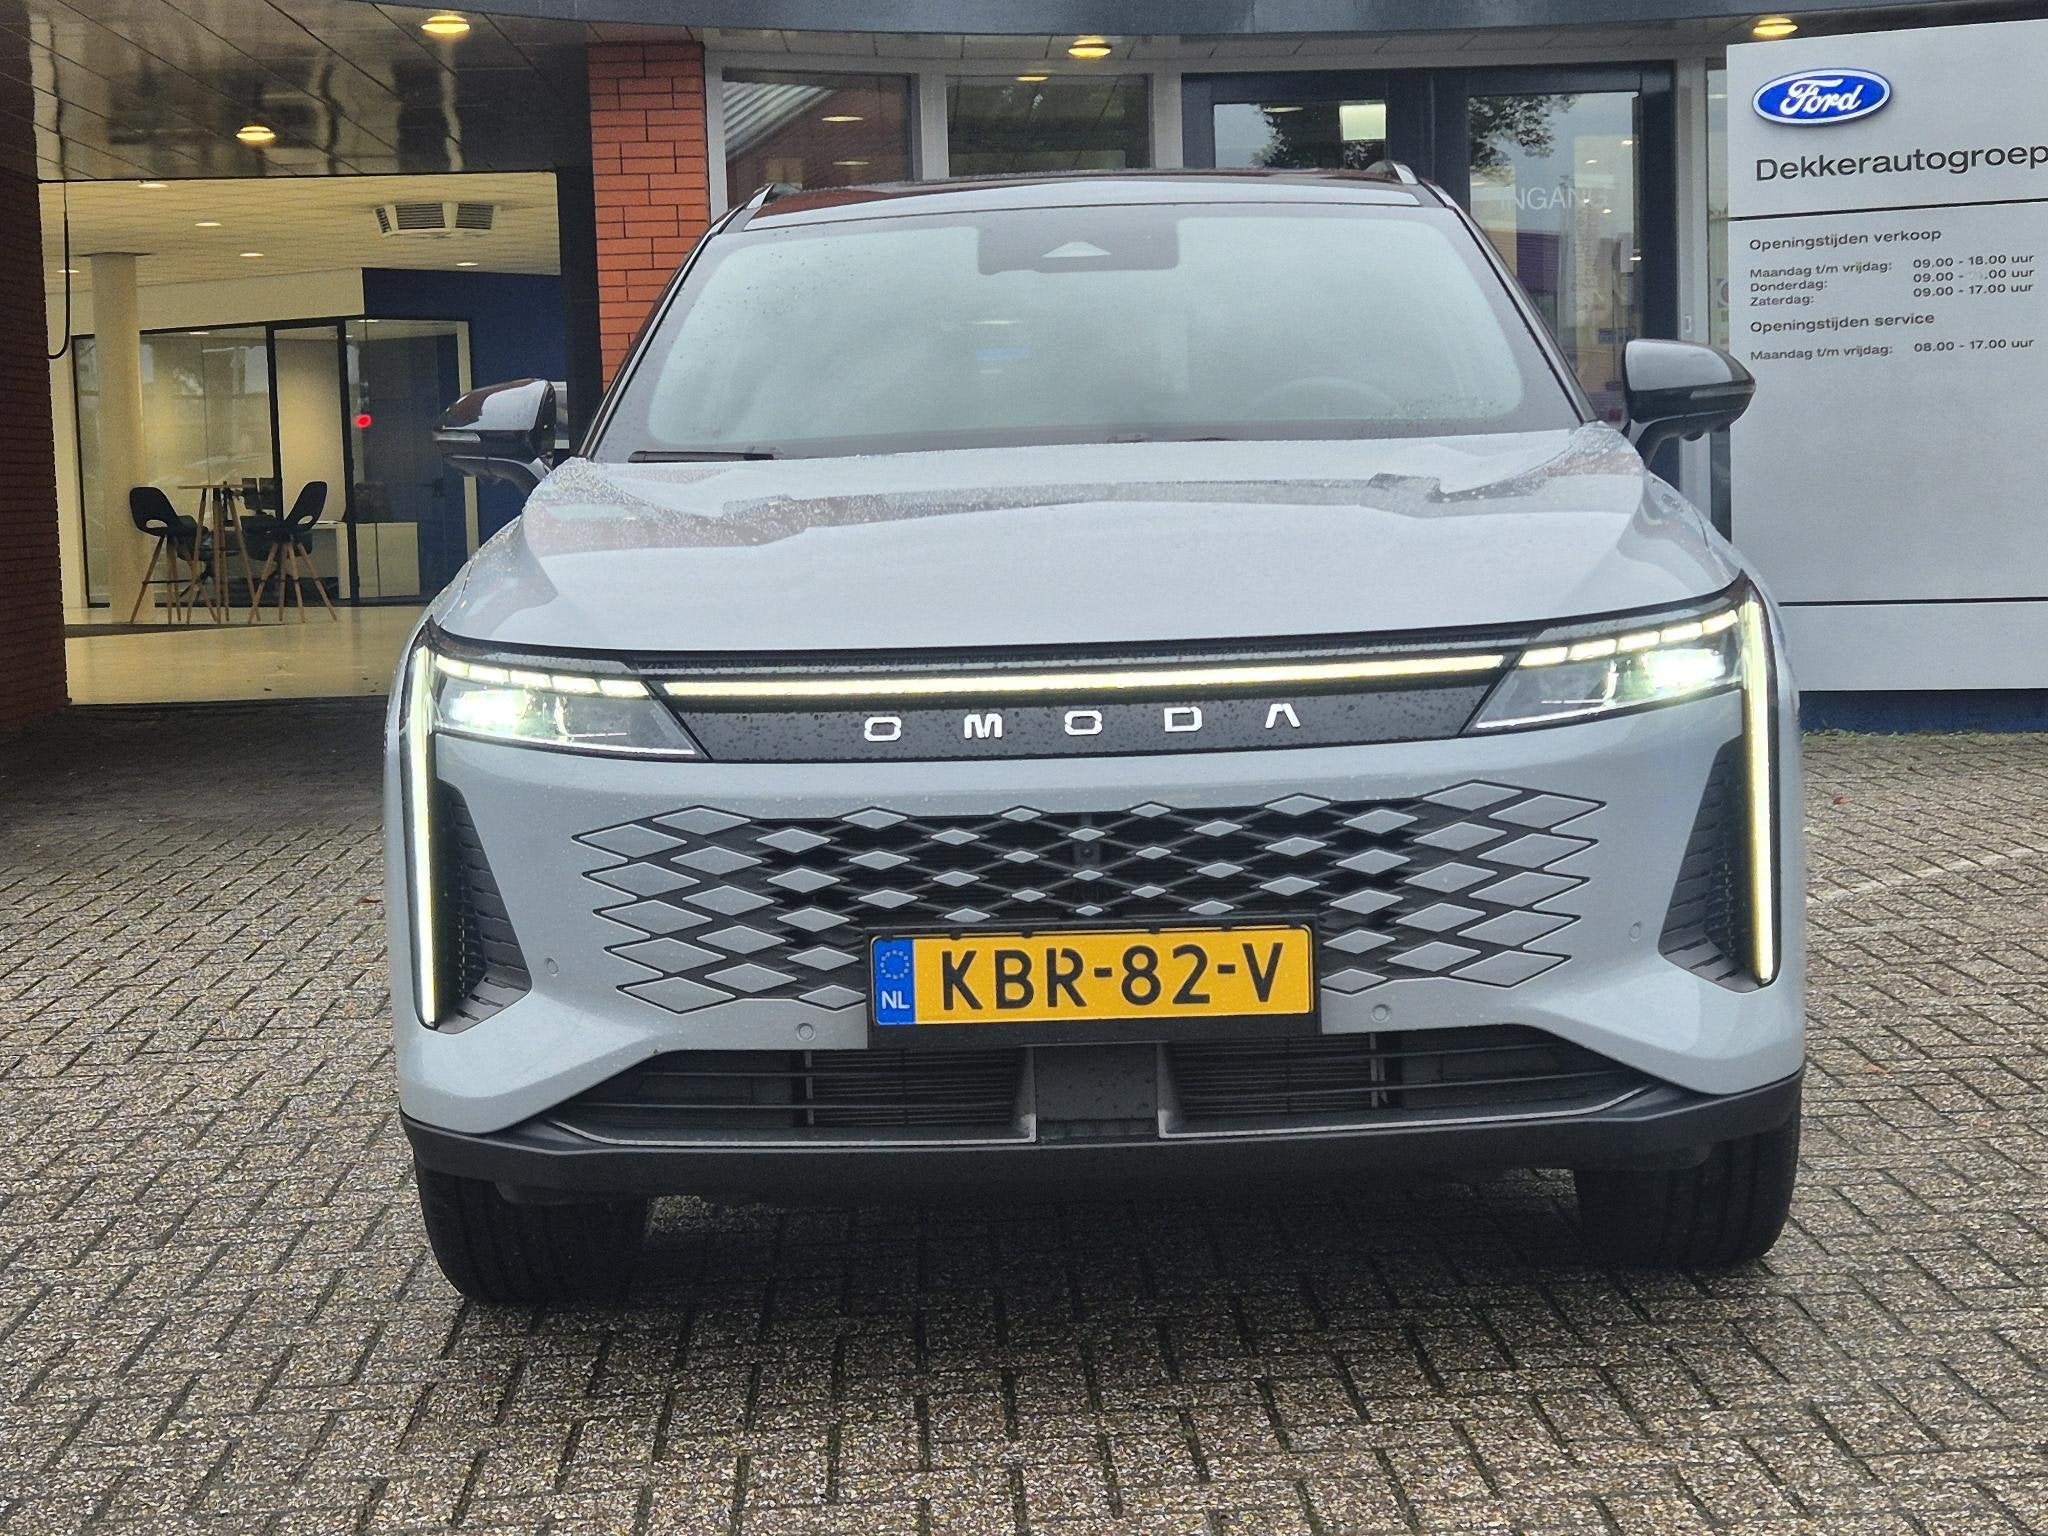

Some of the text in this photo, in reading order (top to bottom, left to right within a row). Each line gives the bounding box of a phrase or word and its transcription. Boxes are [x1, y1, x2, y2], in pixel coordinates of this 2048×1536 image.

[1780, 79, 1865, 115] Ford
[1756, 145, 2048, 181] Dekkerautogroep
[1501, 186, 1610, 210] NGAN
[1750, 229, 1942, 252] Openingstijden verkoop
[1750, 266, 1812, 278] Maandag
[1816, 264, 1838, 275] t/m
[1842, 261, 1892, 275] vrijdag:
[1913, 258, 1954, 269] 09.00
[1968, 255, 2006, 266] 18.00
[2011, 254, 2034, 263] uur
[1751, 280, 1828, 293] Donderdag:
[1913, 272, 1954, 283] 09.00
[2011, 269, 2034, 278] uur
[1750, 295, 1815, 307] Zaterdag:
[1913, 286, 1954, 297] 09.00
[1968, 284, 2006, 295] 17.00
[2011, 283, 2034, 292] uur
[1750, 314, 1935, 334] Openingstijden service
[1751, 350, 1812, 361] Maandag
[1817, 347, 1839, 358] t/m
[1843, 344, 1893, 357] vrijdag:
[1914, 342, 1954, 352] 08.00
[1969, 339, 2006, 350] 17.00
[2011, 338, 2034, 348] uur
[864, 703, 1301, 742] OMODA
[941, 942, 1284, 1011] KBR-82-V
[881, 990, 910, 1010] NL
